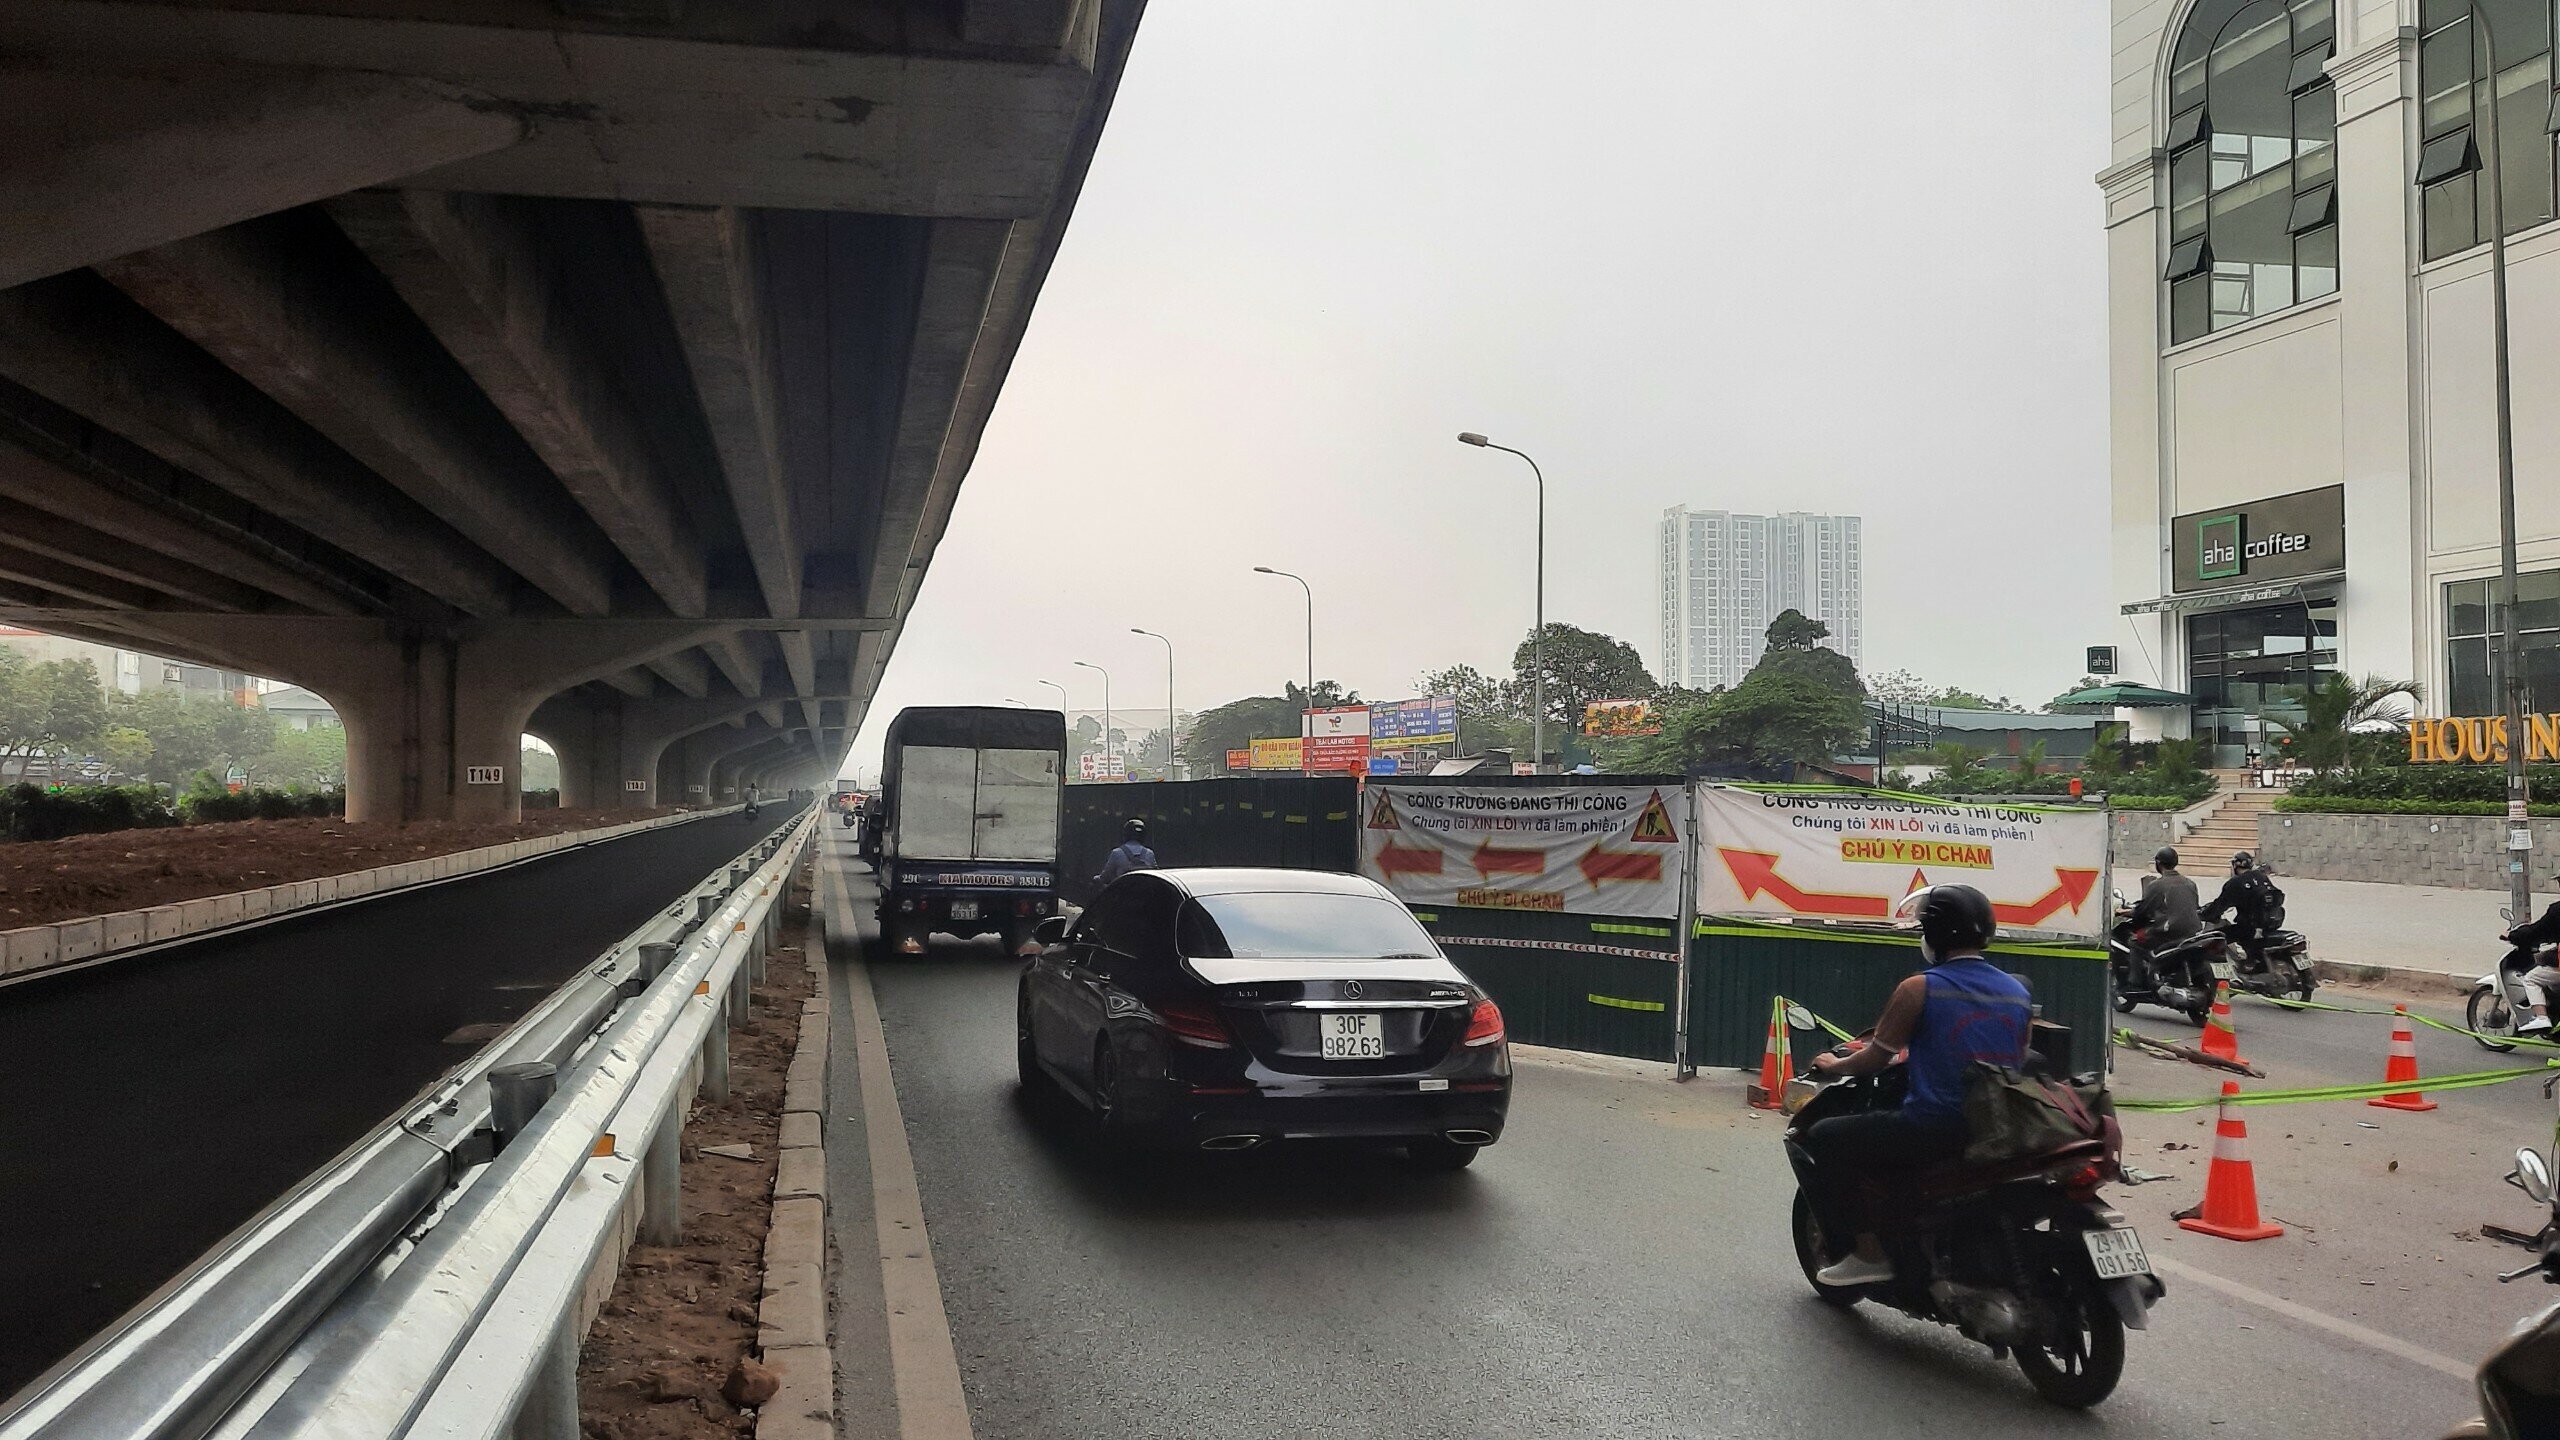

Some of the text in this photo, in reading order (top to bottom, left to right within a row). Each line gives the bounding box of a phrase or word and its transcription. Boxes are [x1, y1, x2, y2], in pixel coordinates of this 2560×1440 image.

[2203, 532, 2307, 565] aha coffee
[2240, 588, 2282, 602] aha coffee
[2092, 655, 2110, 666] aha
[2409, 712, 2560, 764] HOUSN
[469, 768, 500, 782] T149
[1407, 791, 1444, 809] CÔNG
[1510, 796, 1551, 811] ĐANG
[1555, 796, 1579, 810] THI
[1583, 793, 1627, 811] CÔNG
[1472, 818, 1492, 829] XIN
[1535, 819, 1551, 831] đã
[1555, 818, 1577, 832] làm
[1792, 815, 1842, 831] Chúng
[1847, 817, 1866, 829] tôi
[1870, 817, 1894, 831] XIN
[1900, 817, 1923, 832] LỖI
[1928, 821, 1940, 833] vì
[1944, 823, 1961, 834] đã
[1964, 824, 1988, 837] làm
[1991, 826, 2027, 841] phiền
[1841, 838, 1885, 859] CHÚ
[1892, 839, 1905, 859] Ý
[1911, 843, 1931, 860] ĐI
[938, 874, 961, 885] KIA
[962, 874, 1014, 886] MOTORS
[1336, 1016, 1367, 1035] 30F
[1325, 1037, 1381, 1056] 982.63
